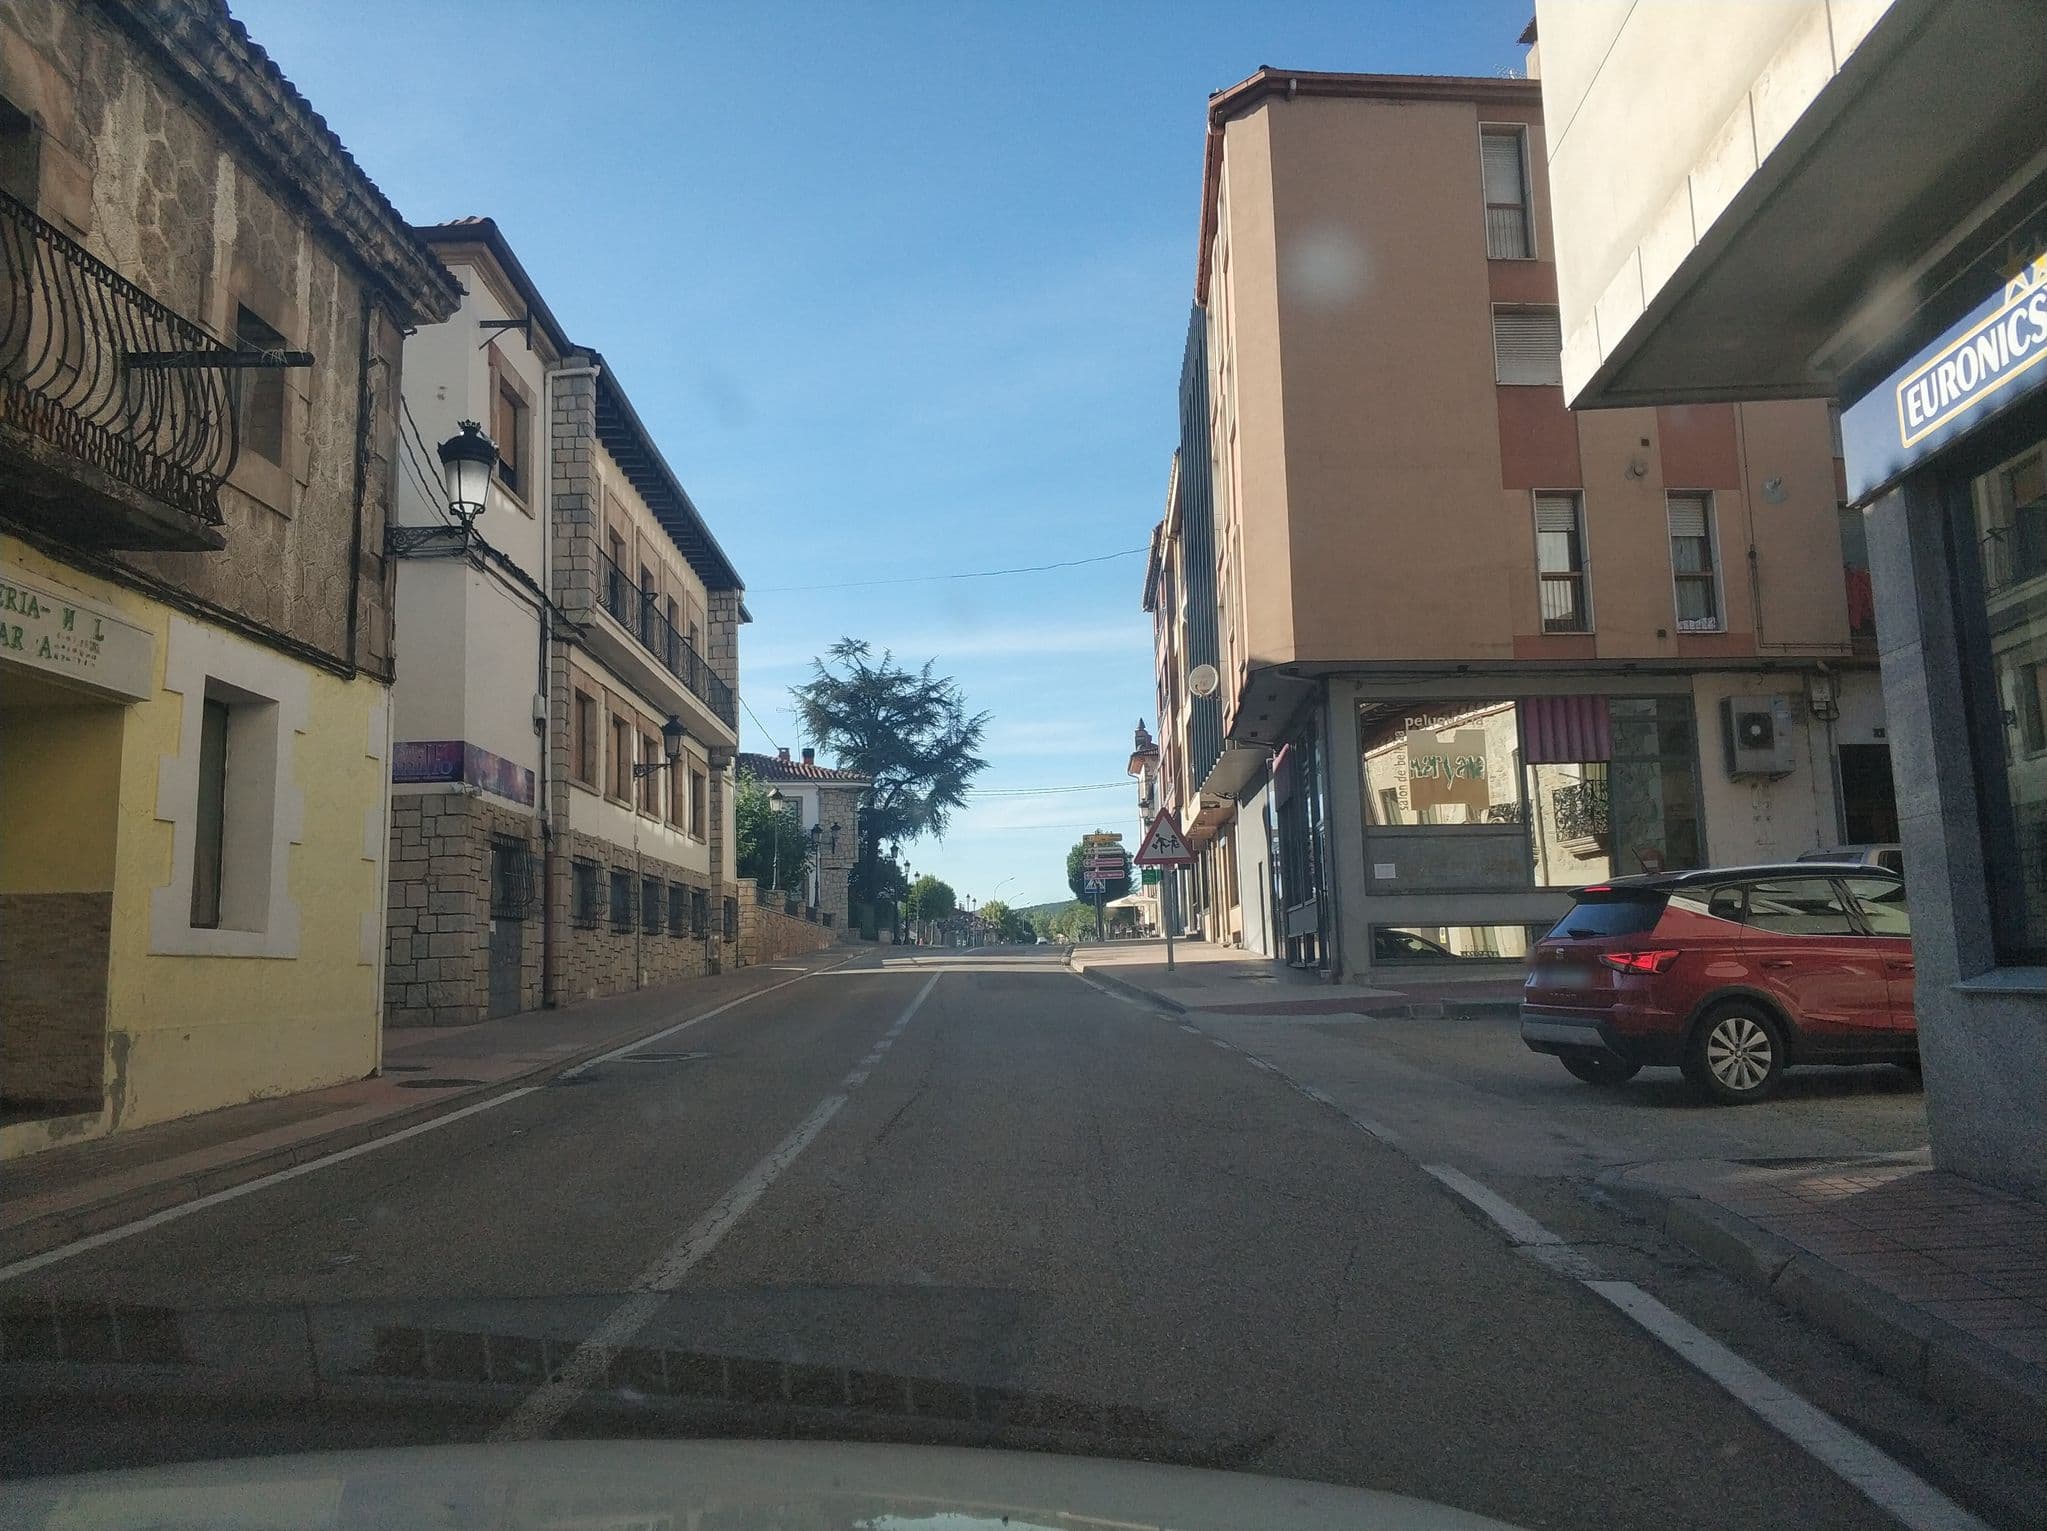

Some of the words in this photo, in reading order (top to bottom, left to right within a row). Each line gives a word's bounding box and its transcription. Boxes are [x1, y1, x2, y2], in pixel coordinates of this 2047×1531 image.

[1907, 291, 2047, 427] EURONICS
[1393, 730, 1408, 767] belza
[1393, 770, 1408, 783] de
